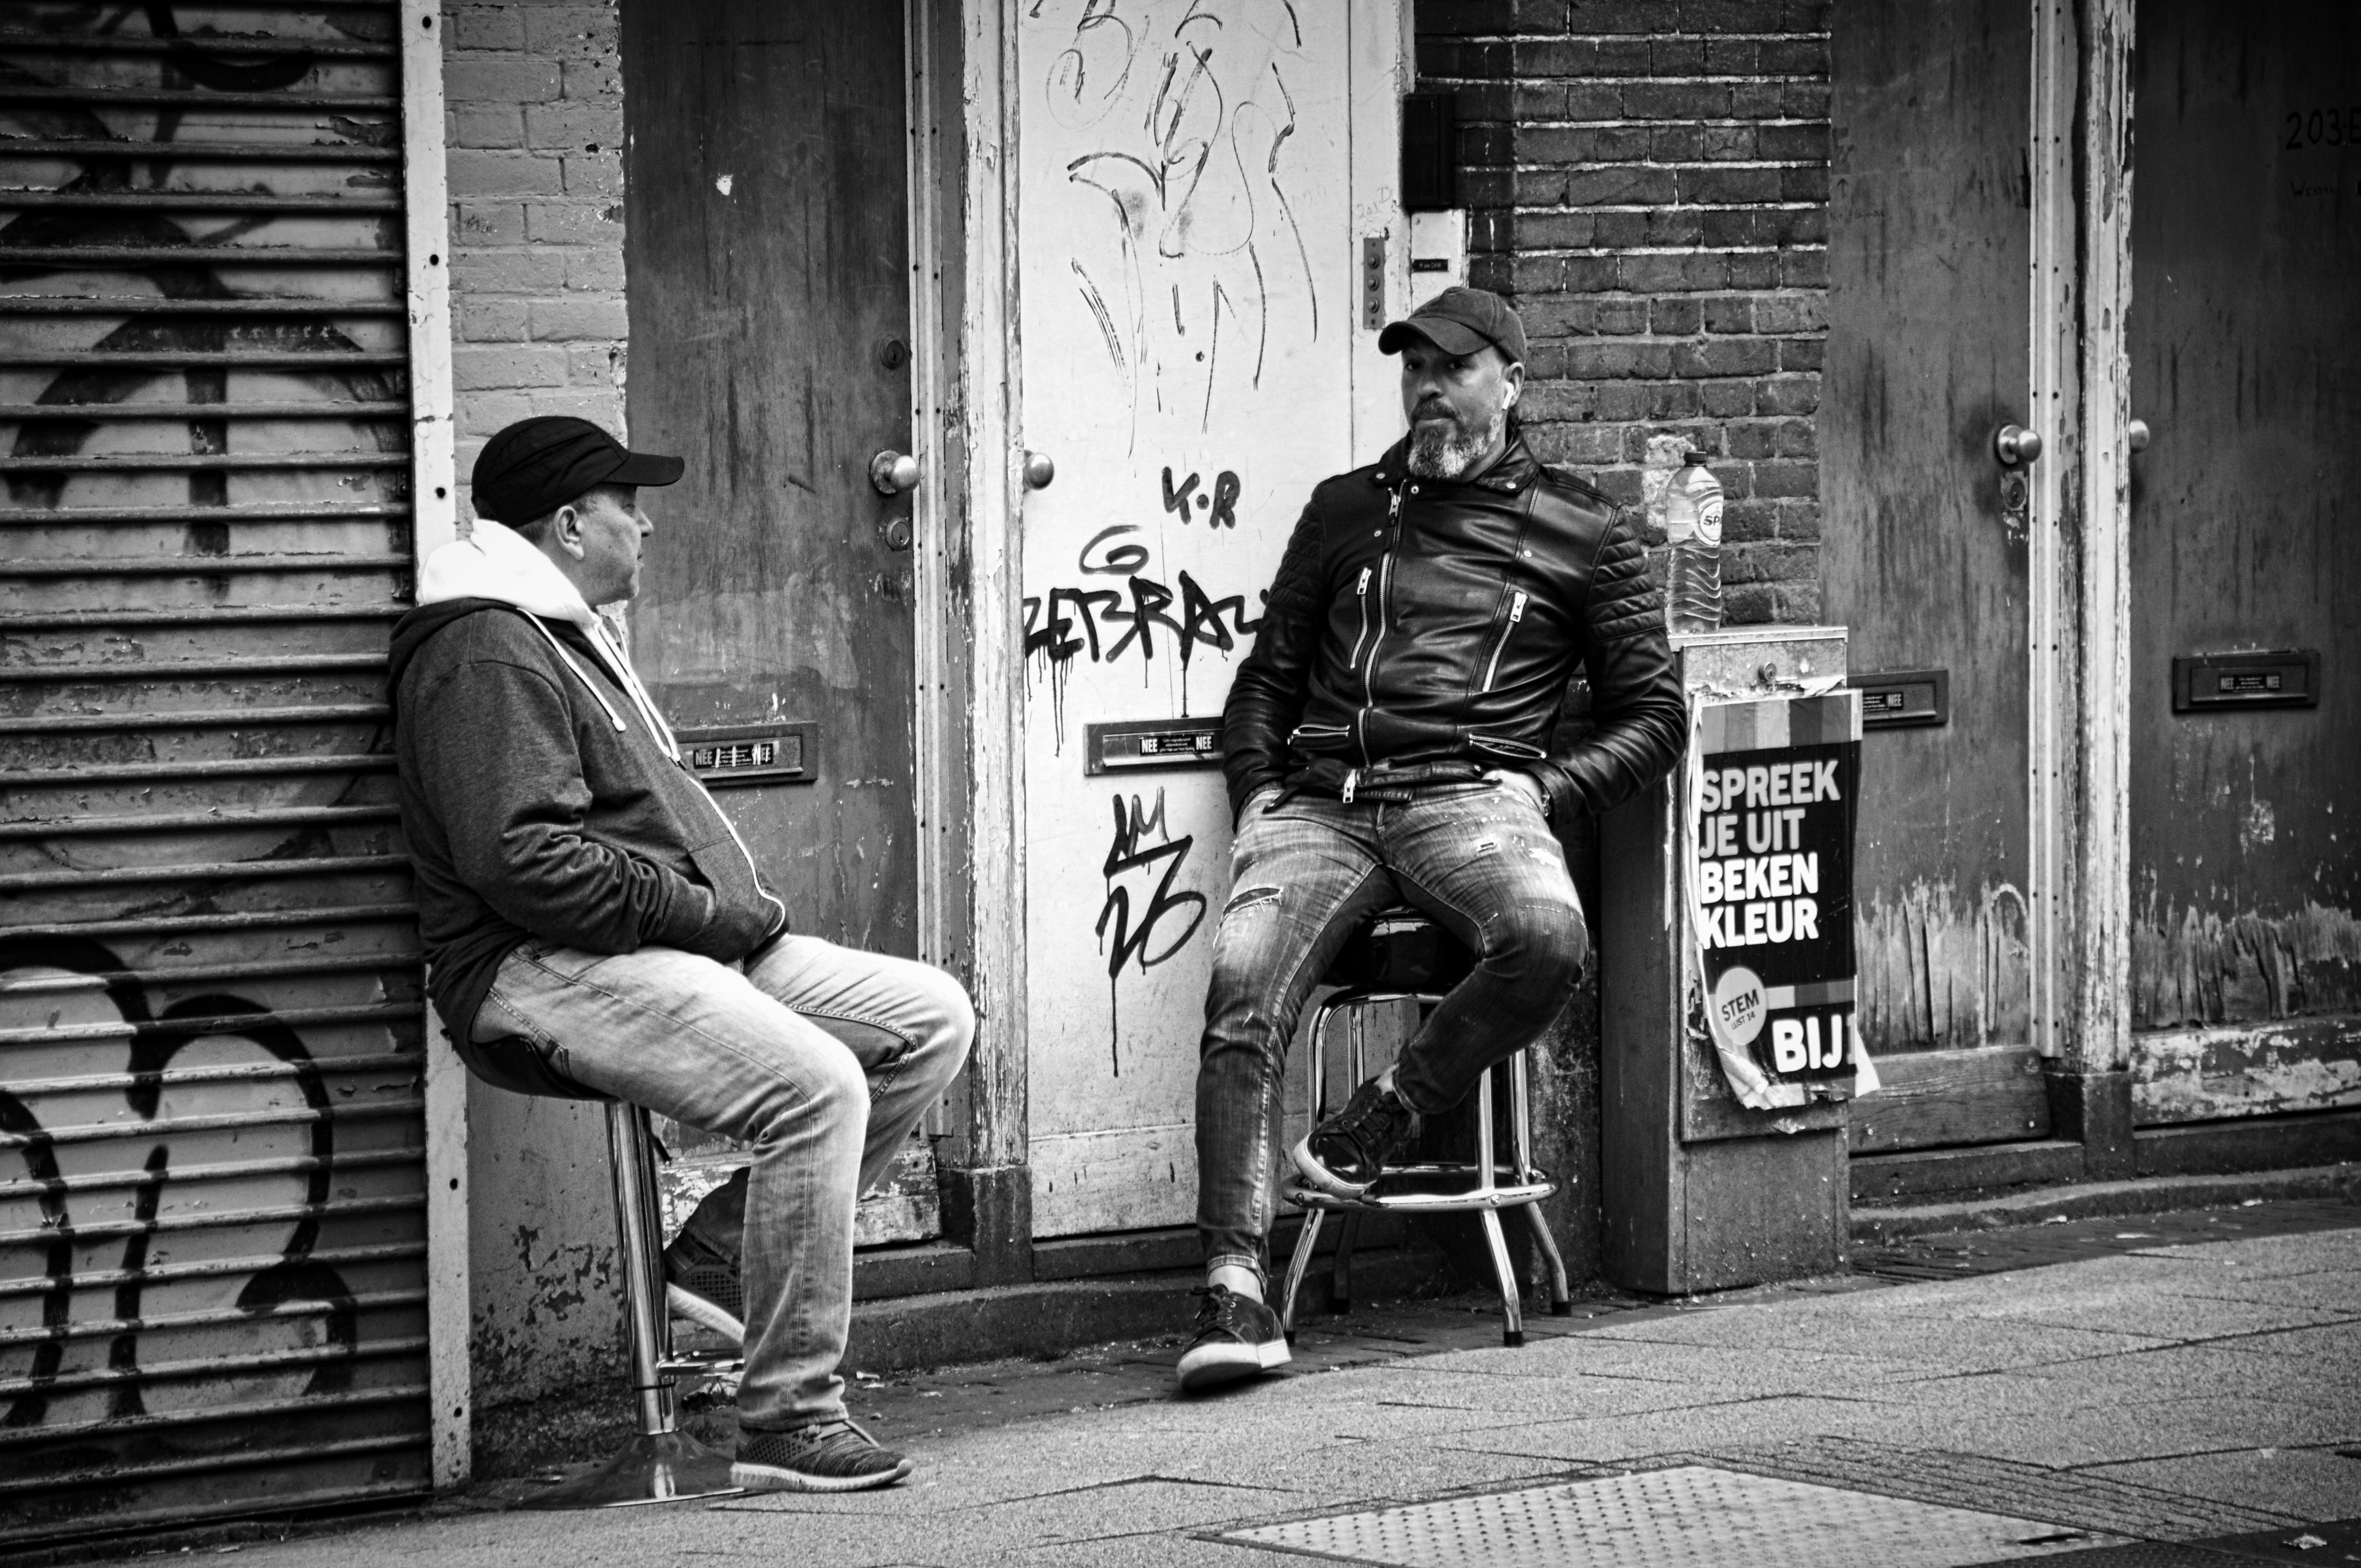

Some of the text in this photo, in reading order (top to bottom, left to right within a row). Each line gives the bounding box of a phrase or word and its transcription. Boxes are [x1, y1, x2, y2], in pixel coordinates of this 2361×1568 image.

[695, 750, 712, 765] NEE
[1141, 738, 1158, 754] NEE
[1196, 736, 1212, 751] NEE
[1701, 760, 1841, 812] SPREEK
[1699, 808, 1806, 858] JE UIT
[1700, 851, 1819, 904] BEKEN
[1701, 898, 1819, 950] KLEUR
[1722, 989, 1760, 1022] STEM
[1747, 1011, 1755, 1021] 14
